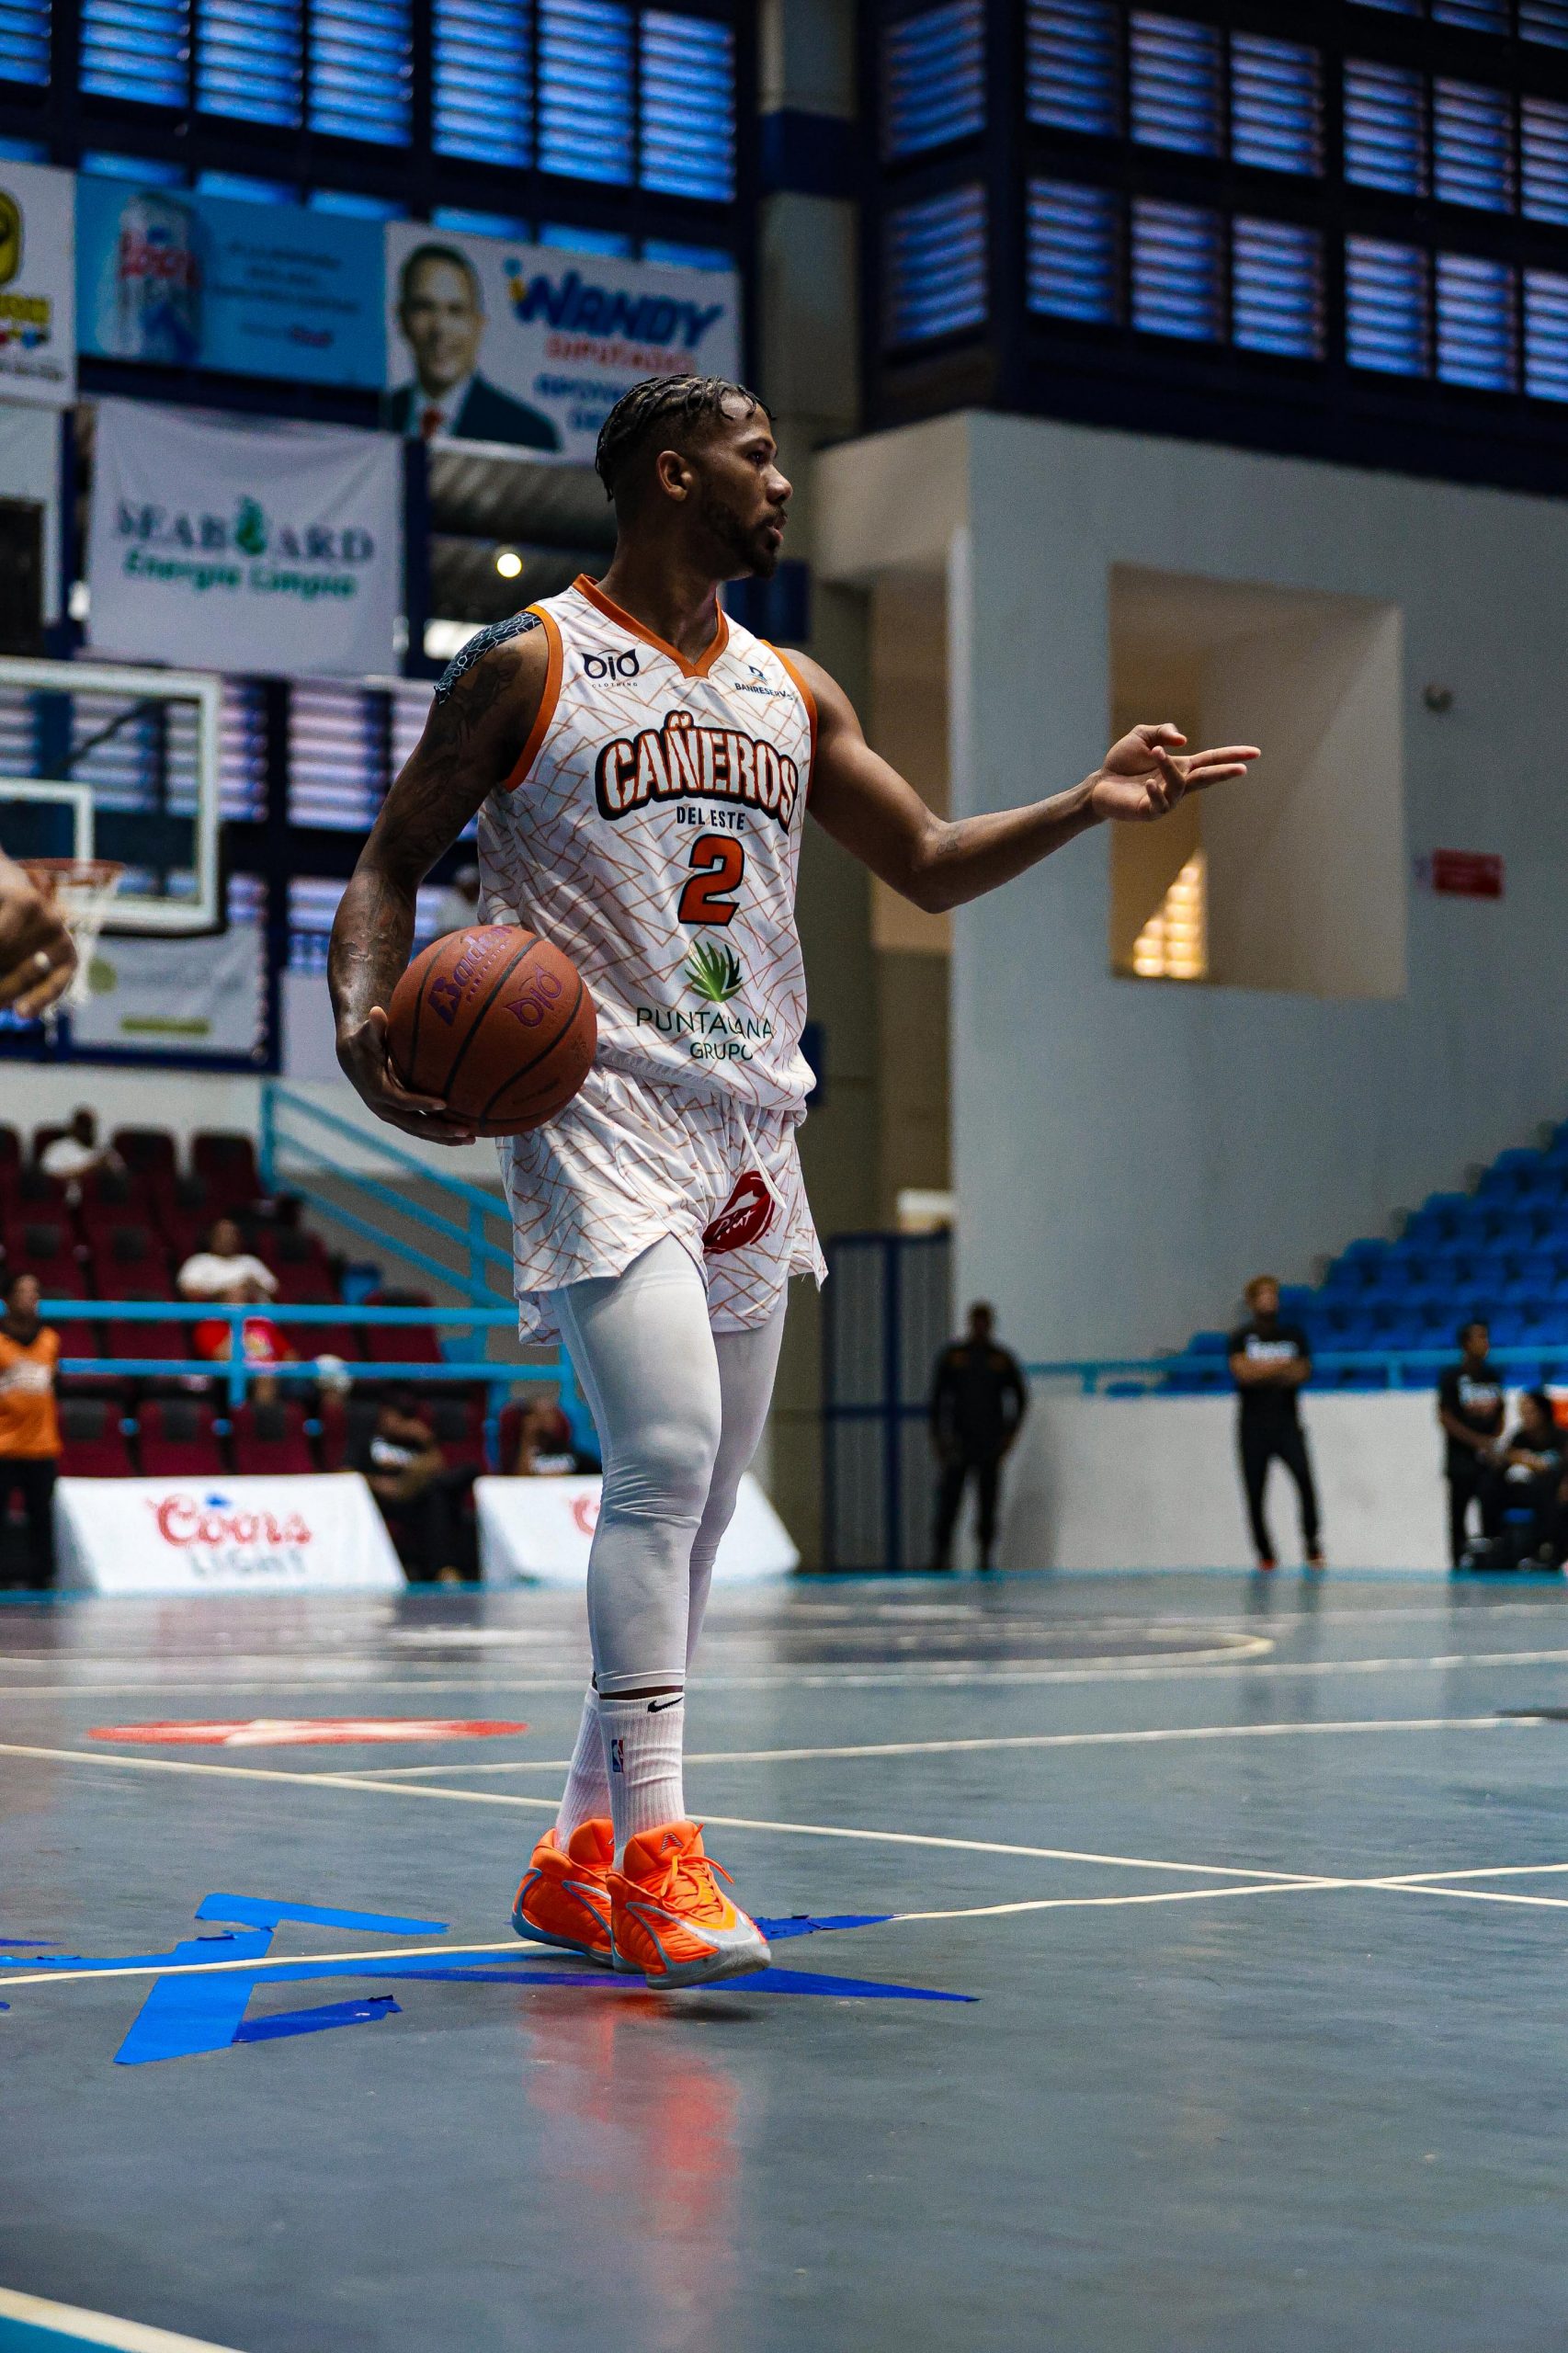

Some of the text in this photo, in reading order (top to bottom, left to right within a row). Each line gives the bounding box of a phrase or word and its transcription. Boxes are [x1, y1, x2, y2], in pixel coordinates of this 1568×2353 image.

[595, 710, 799, 835] CAÑEROS
[676, 806, 745, 831] DEL ESTE
[677, 834, 744, 926] 2
